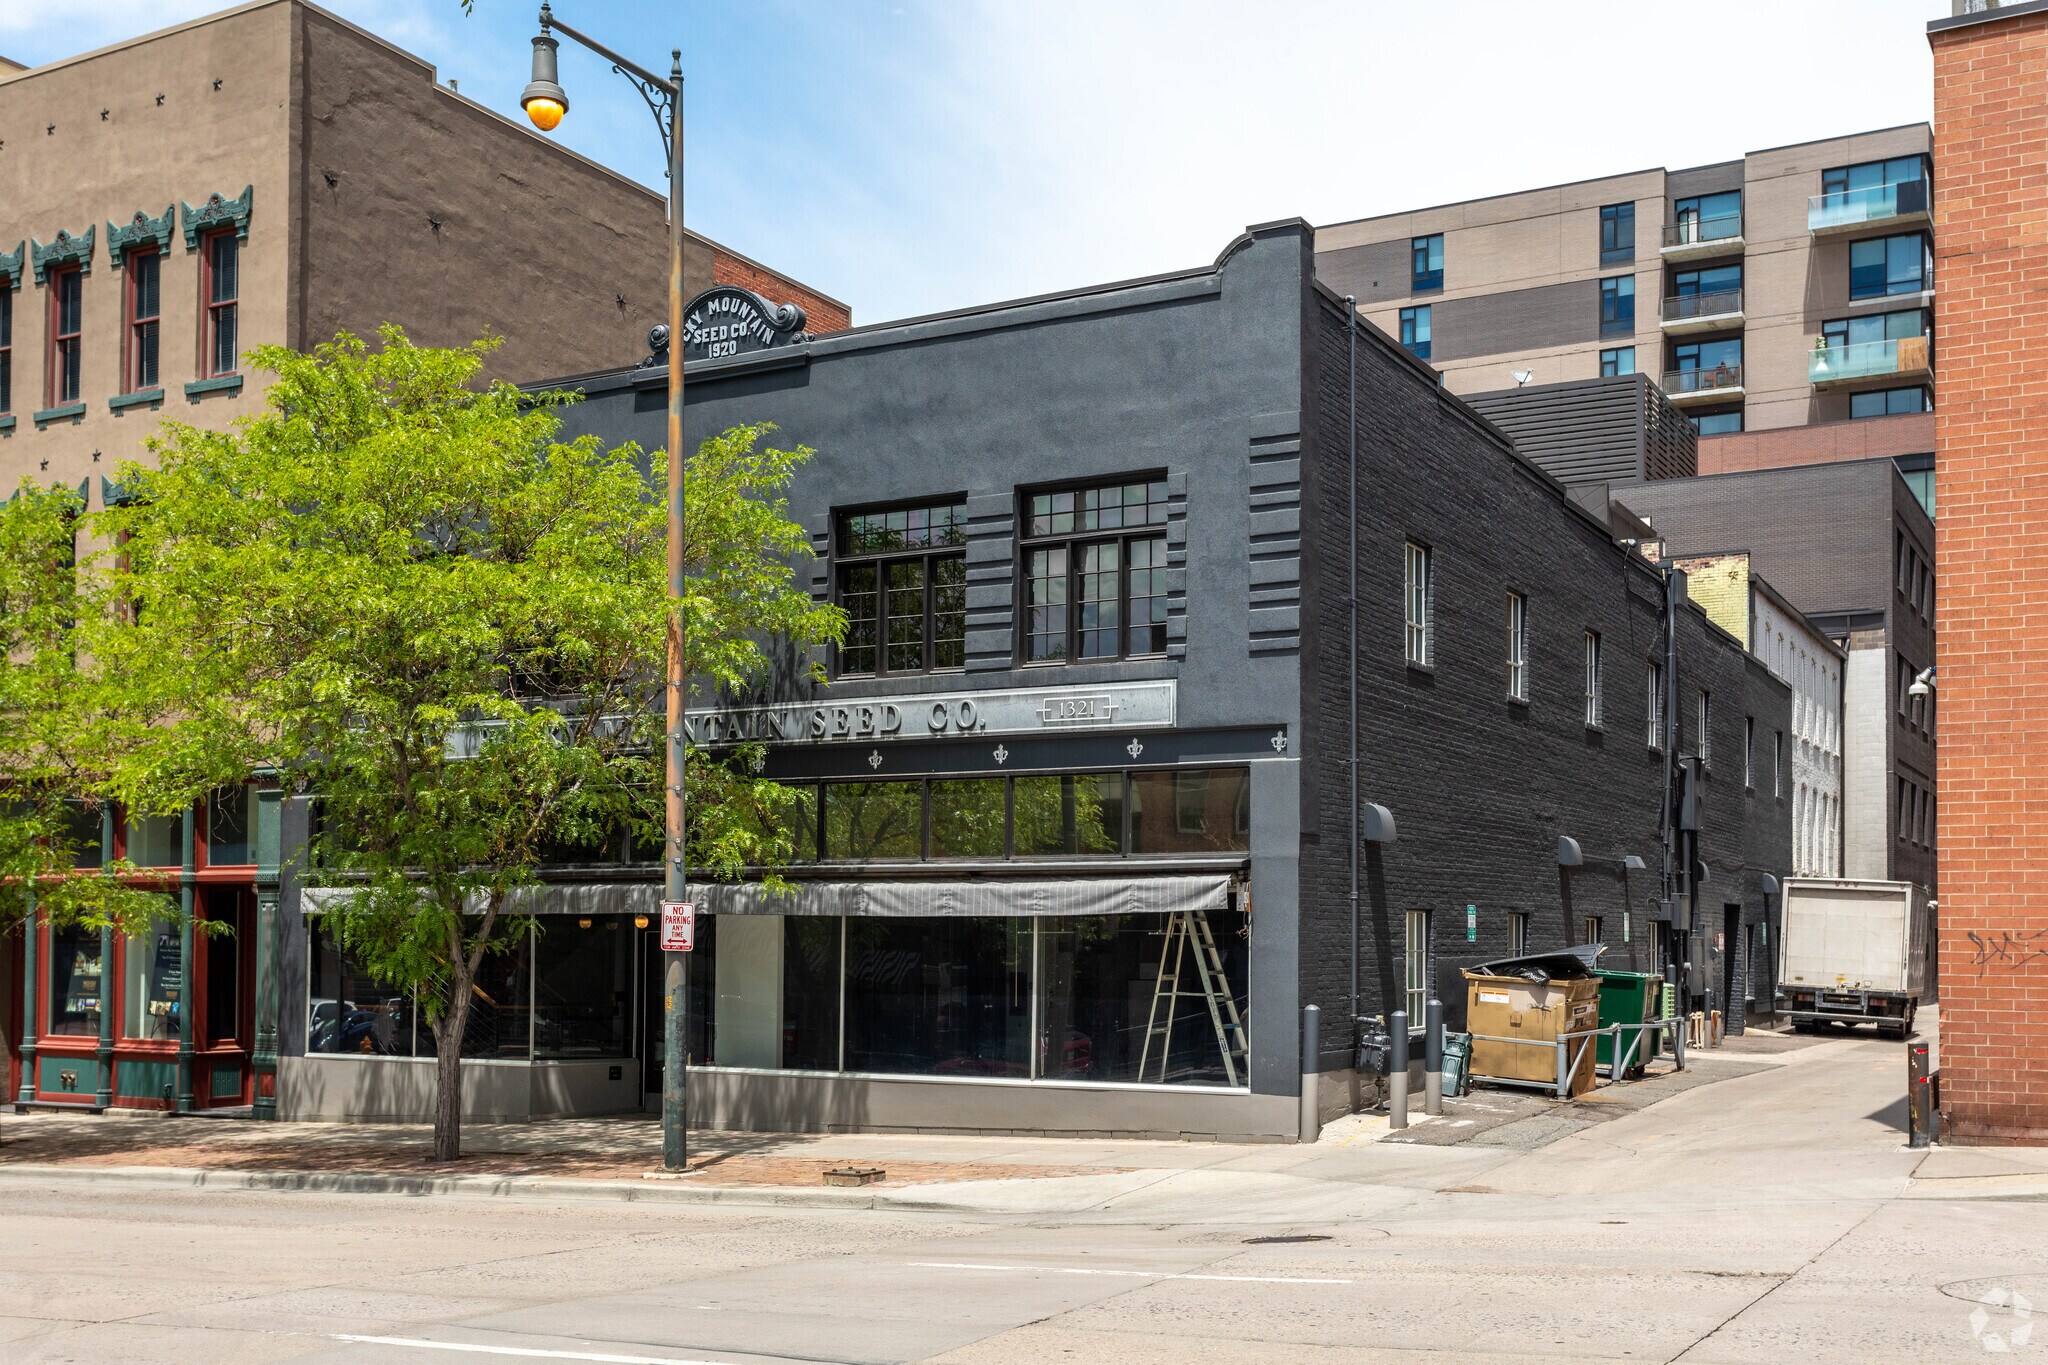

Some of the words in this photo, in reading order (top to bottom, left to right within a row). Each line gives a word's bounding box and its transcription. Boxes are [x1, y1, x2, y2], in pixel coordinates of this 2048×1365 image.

[708, 297, 775, 345] MOUNTAIN
[694, 325, 728, 344] SEED
[730, 321, 751, 338] CO.
[708, 340, 737, 359] 1920
[1058, 700, 1095, 717] 1321
[811, 703, 900, 735] SEED
[665, 915, 691, 925] PARKING
[672, 906, 684, 915] NO
